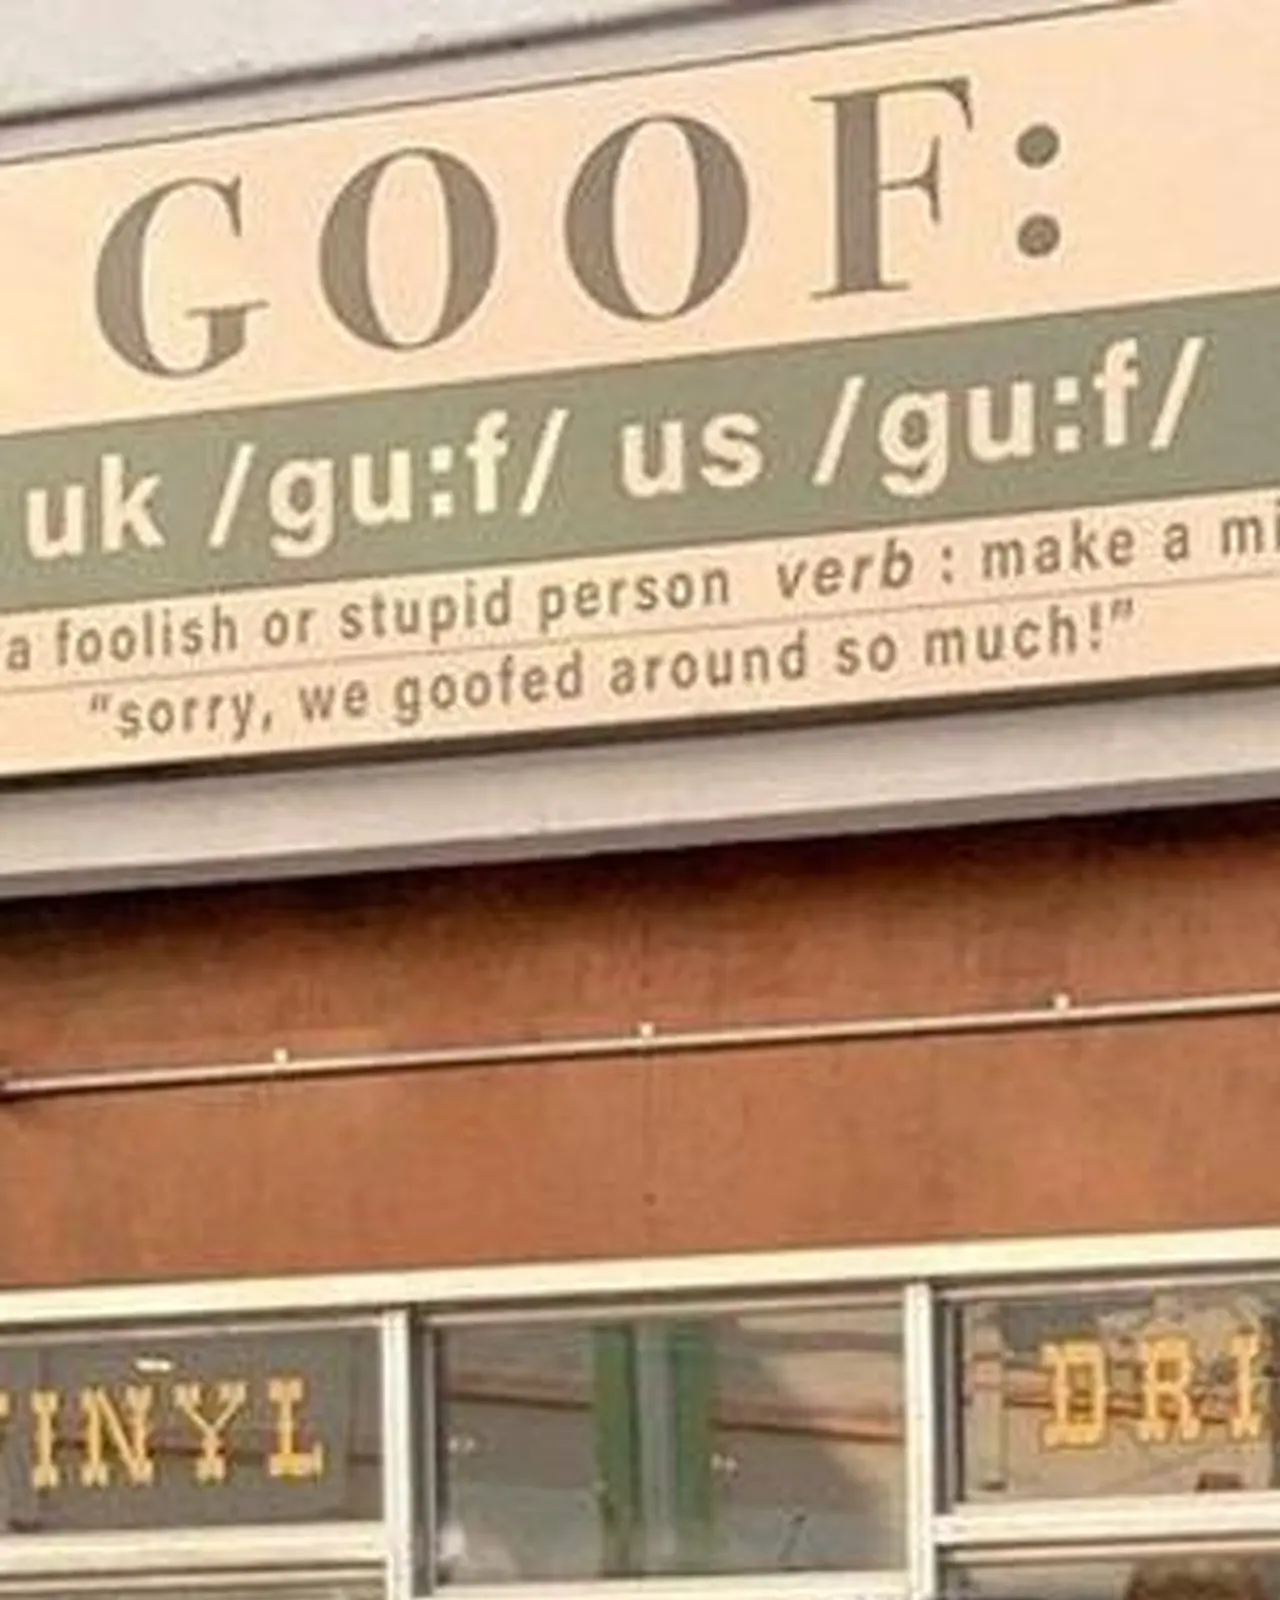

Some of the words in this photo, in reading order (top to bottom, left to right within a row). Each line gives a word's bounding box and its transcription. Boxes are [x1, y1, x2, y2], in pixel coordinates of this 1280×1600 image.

[94, 76, 1060, 379] GOOF:
[26, 454, 166, 560] uk
[209, 408, 567, 558] /gu:f/
[621, 410, 765, 498] us
[812, 336, 1206, 496] /gu:f/
[6, 637, 33, 672] a
[56, 605, 239, 668] foolish
[263, 605, 314, 648] or
[339, 579, 515, 655] stupid
[538, 563, 733, 642] person
[775, 540, 915, 597] verb
[981, 520, 1137, 580] make
[1162, 524, 1192, 562] a
[299, 678, 370, 725] we
[392, 650, 586, 727] goofed
[609, 628, 806, 697] around
[836, 633, 898, 679] so
